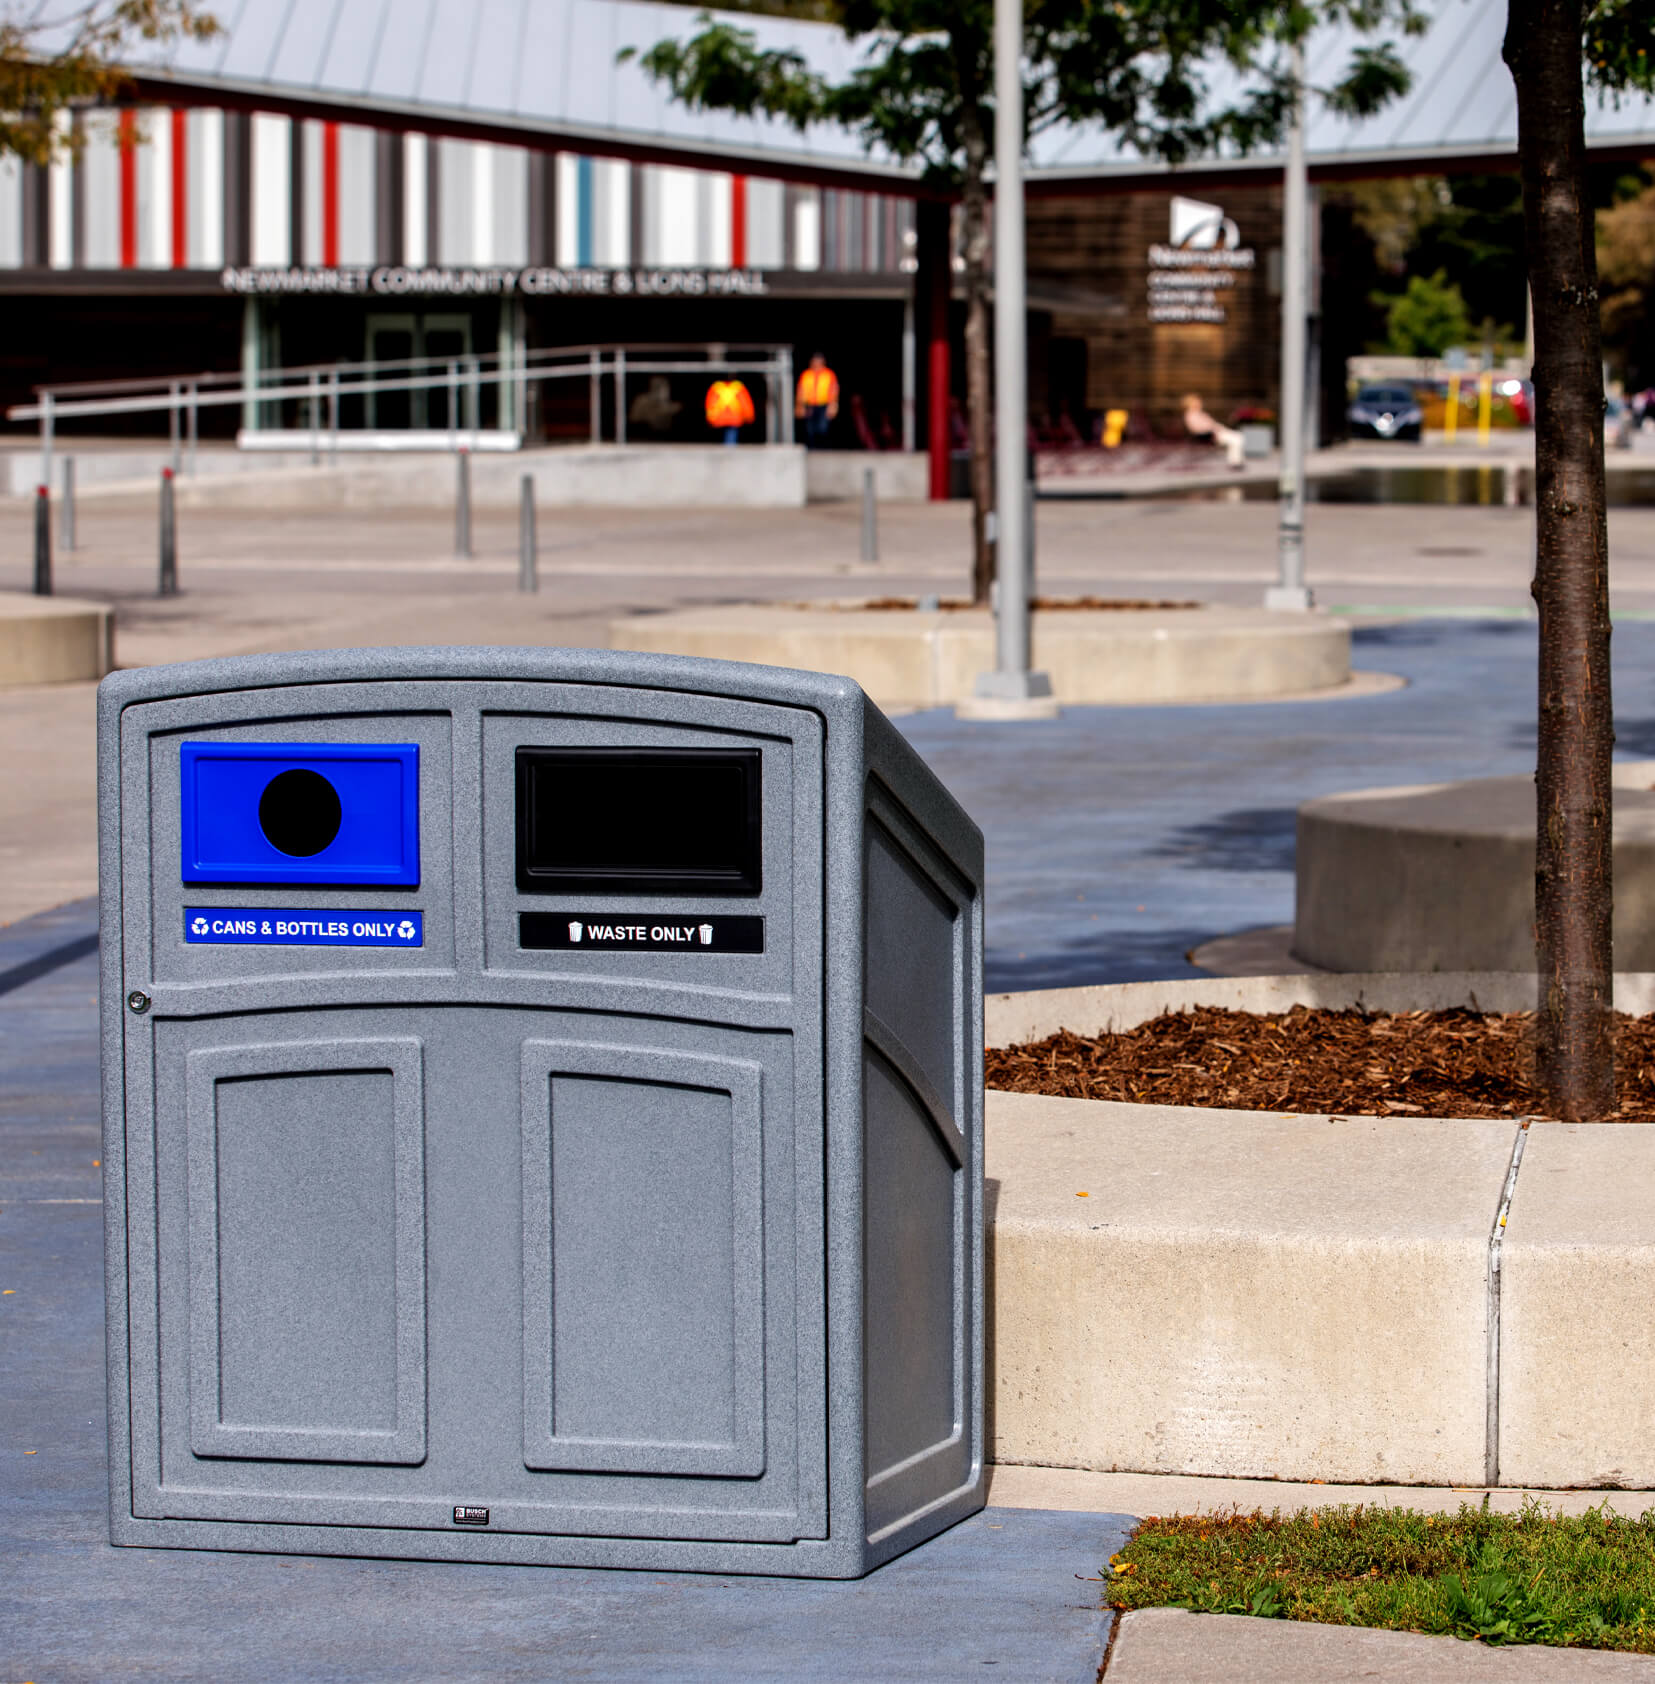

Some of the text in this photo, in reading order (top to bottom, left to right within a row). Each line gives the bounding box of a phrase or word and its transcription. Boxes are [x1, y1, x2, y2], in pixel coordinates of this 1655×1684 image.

[222, 266, 369, 294] NEWMARKET
[371, 266, 516, 295] COMMUNITY
[520, 267, 609, 295] CENTRE
[212, 920, 395, 937] CANS & BOTTLES ONLY
[587, 926, 696, 942] WASTE ONLY
